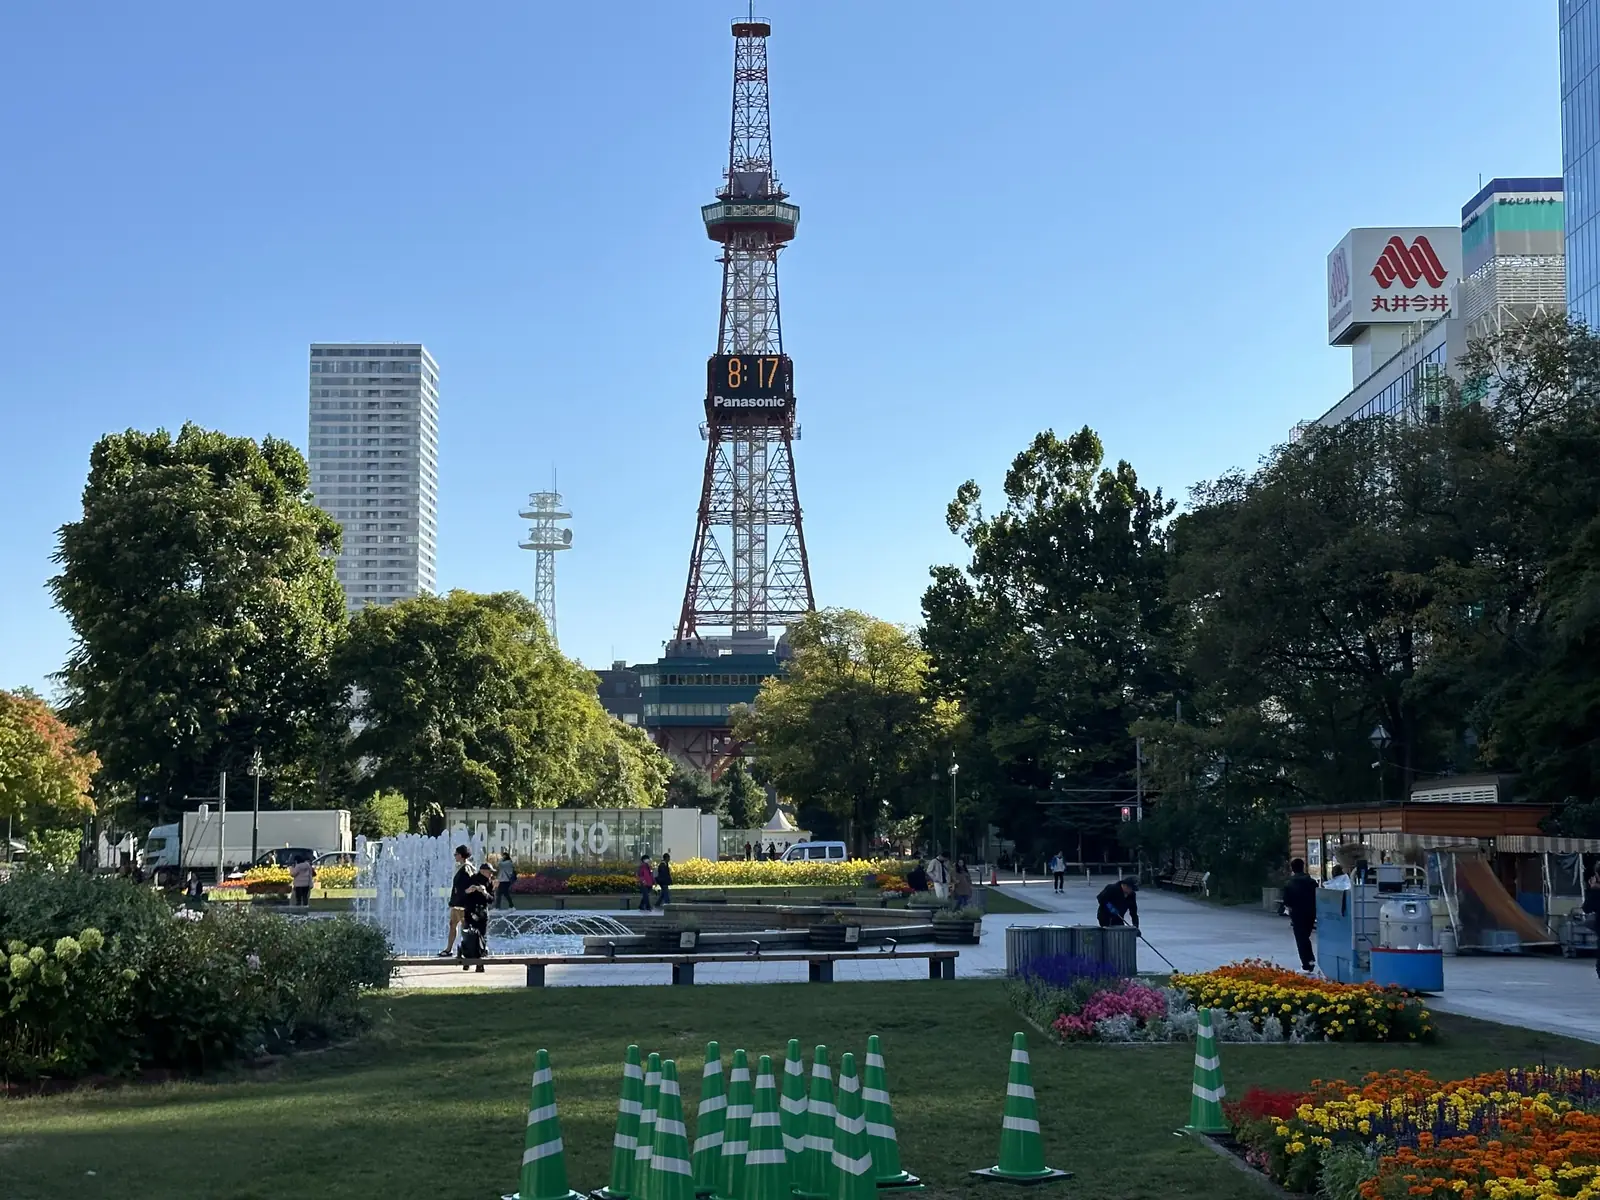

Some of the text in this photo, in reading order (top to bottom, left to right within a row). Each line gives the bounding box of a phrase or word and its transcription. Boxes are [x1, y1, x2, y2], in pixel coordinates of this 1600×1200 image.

[1371, 294, 1449, 312] 丸井今井
[728, 358, 779, 388] 8:17
[713, 395, 786, 408] Panasonic
